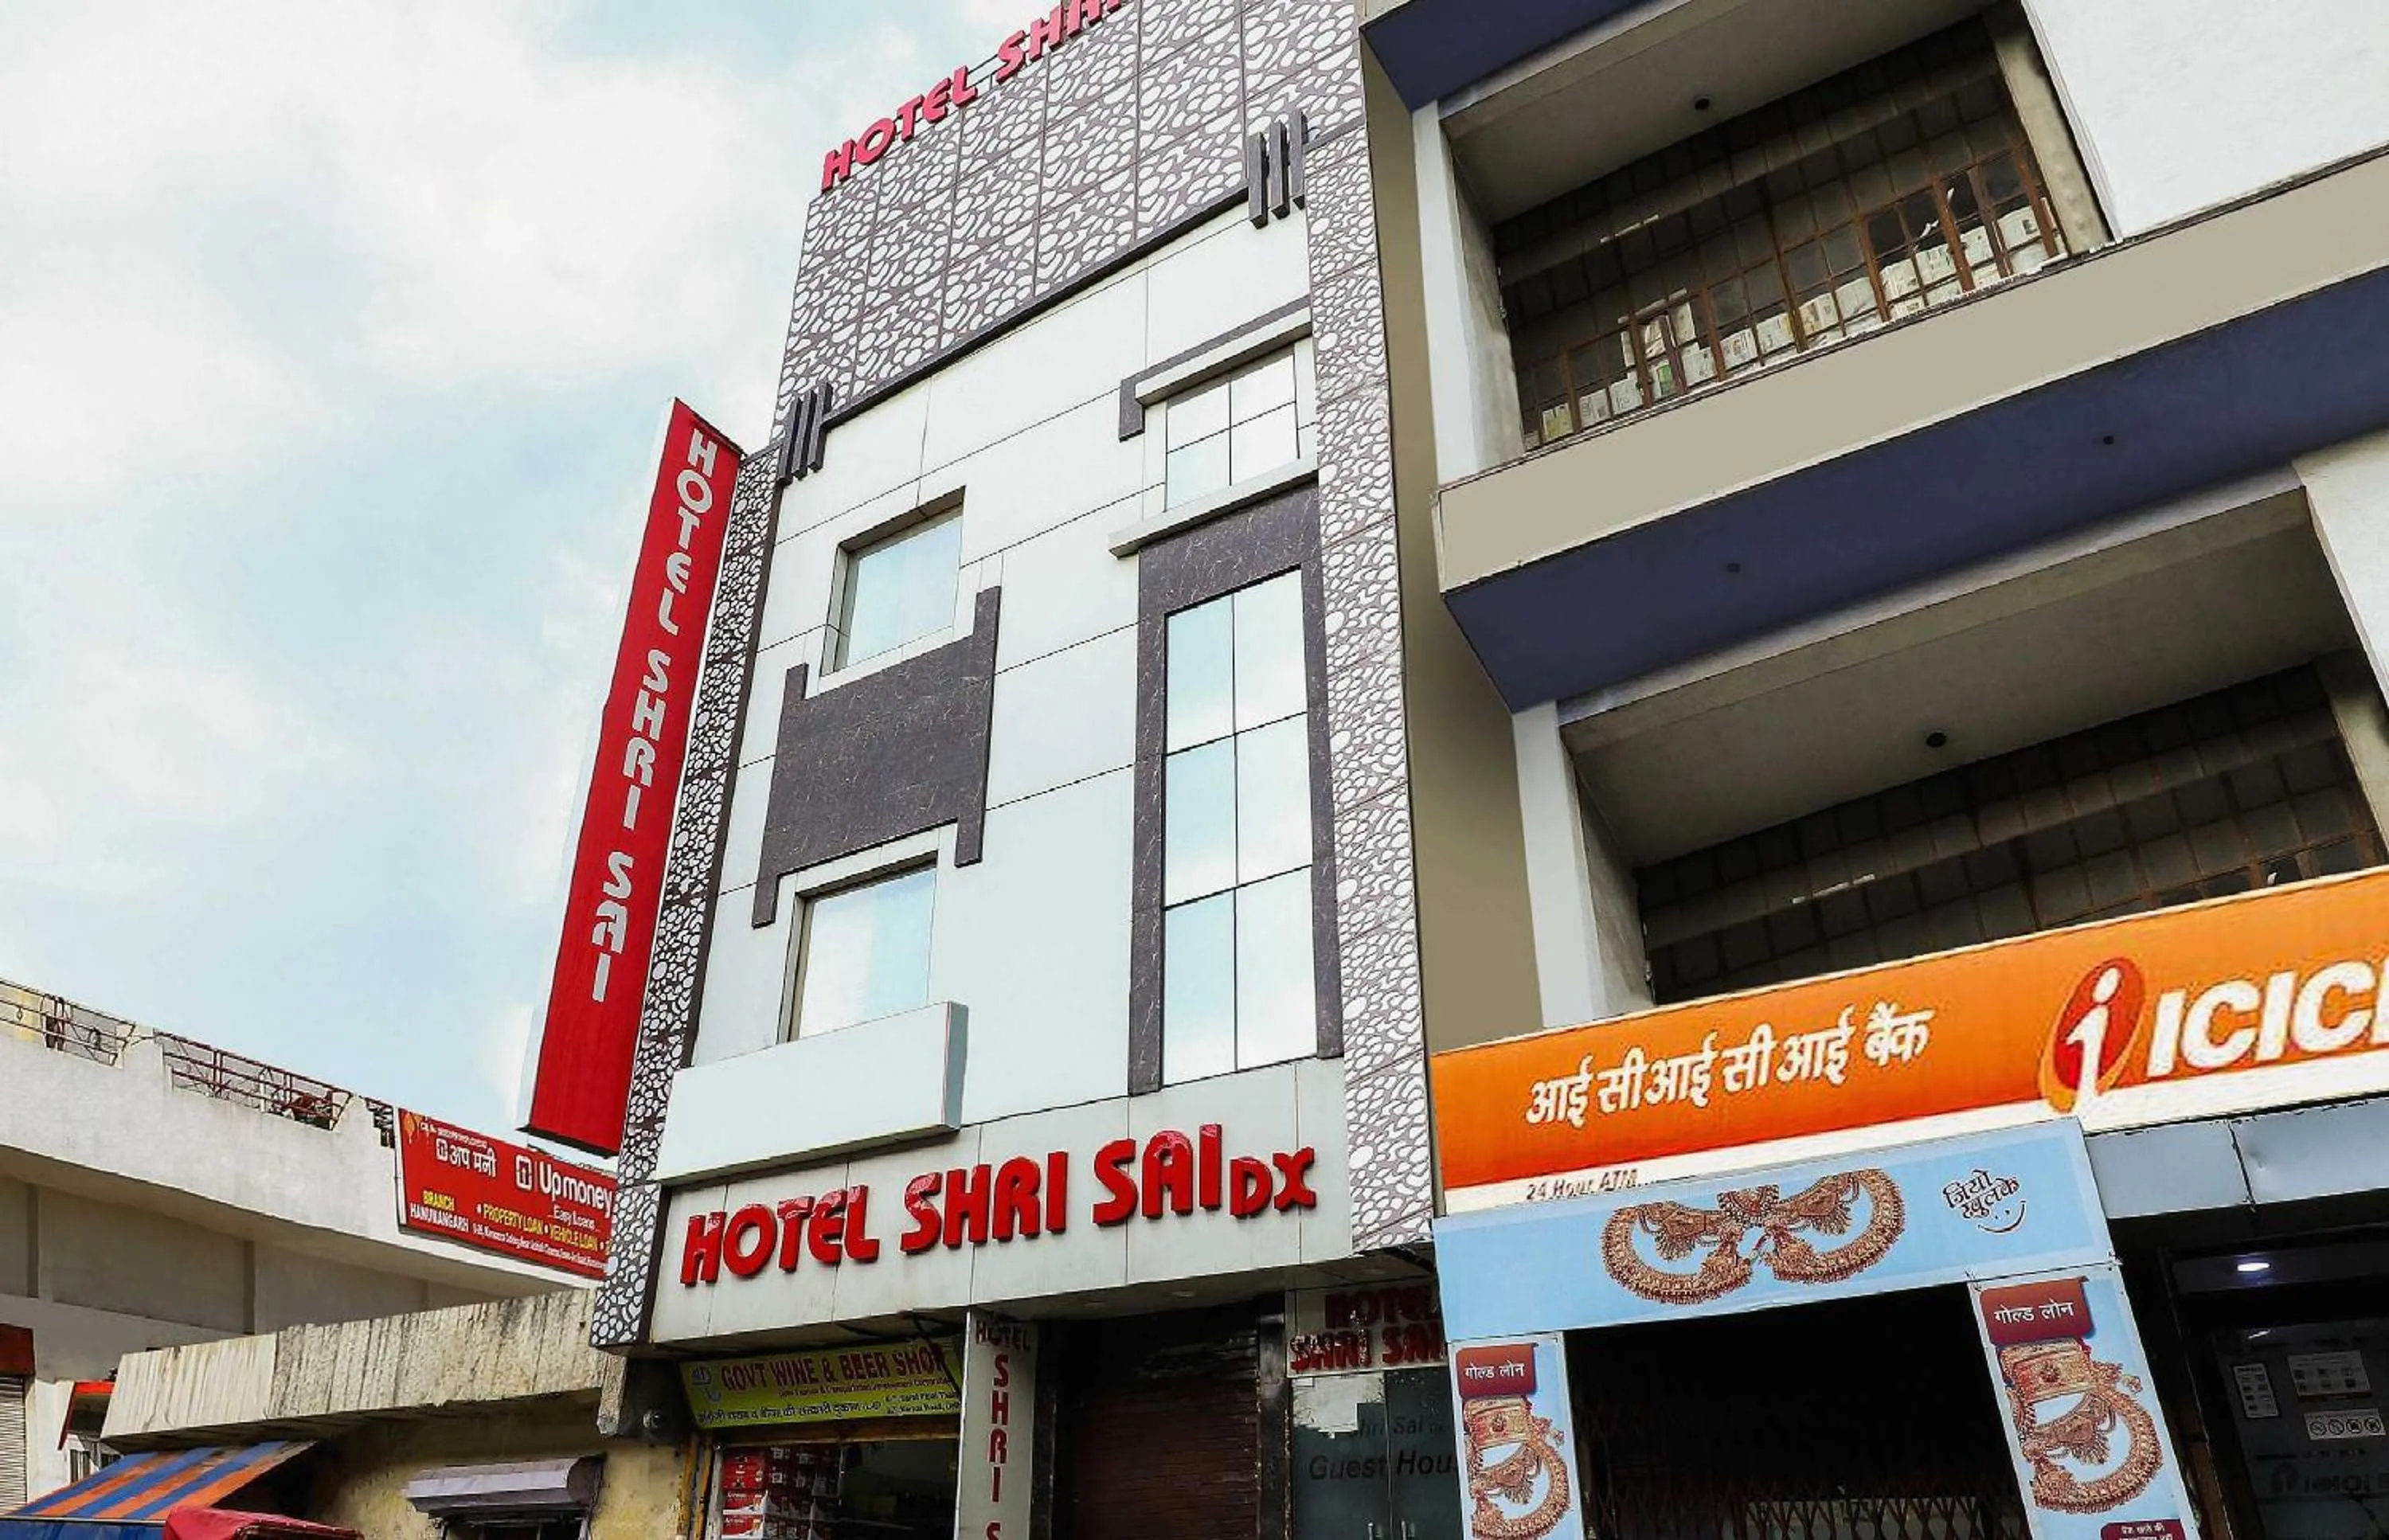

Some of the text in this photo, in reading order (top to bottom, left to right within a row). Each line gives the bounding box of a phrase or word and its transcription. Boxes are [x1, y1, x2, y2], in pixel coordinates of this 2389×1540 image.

[821, 0, 1121, 193] HOTEL SHR
[592, 427, 717, 1003] HOTEL SHRI SAI
[1864, 1001, 1936, 1066] बैंक
[540, 1160, 612, 1218] Upmoney
[681, 1185, 878, 1287] HOTEL
[901, 1151, 1068, 1254] SHRI
[1093, 1124, 1222, 1226] SAI
[1230, 1147, 1316, 1218] DX
[483, 1203, 523, 1229] PROPERTY
[522, 1216, 544, 1235] LOAN
[1994, 1297, 2074, 1323] गोल्ड लोन
[976, 1320, 1030, 1351] HOTEL
[721, 1362, 767, 1391] GOVT
[769, 1358, 819, 1386] WINE
[821, 1356, 839, 1383] &
[839, 1351, 890, 1380] BEER
[1464, 1360, 1526, 1380] गोल्ड लोन
[987, 1354, 1009, 1503] SHRI
[1309, 1449, 1456, 1479] Guest Hou
